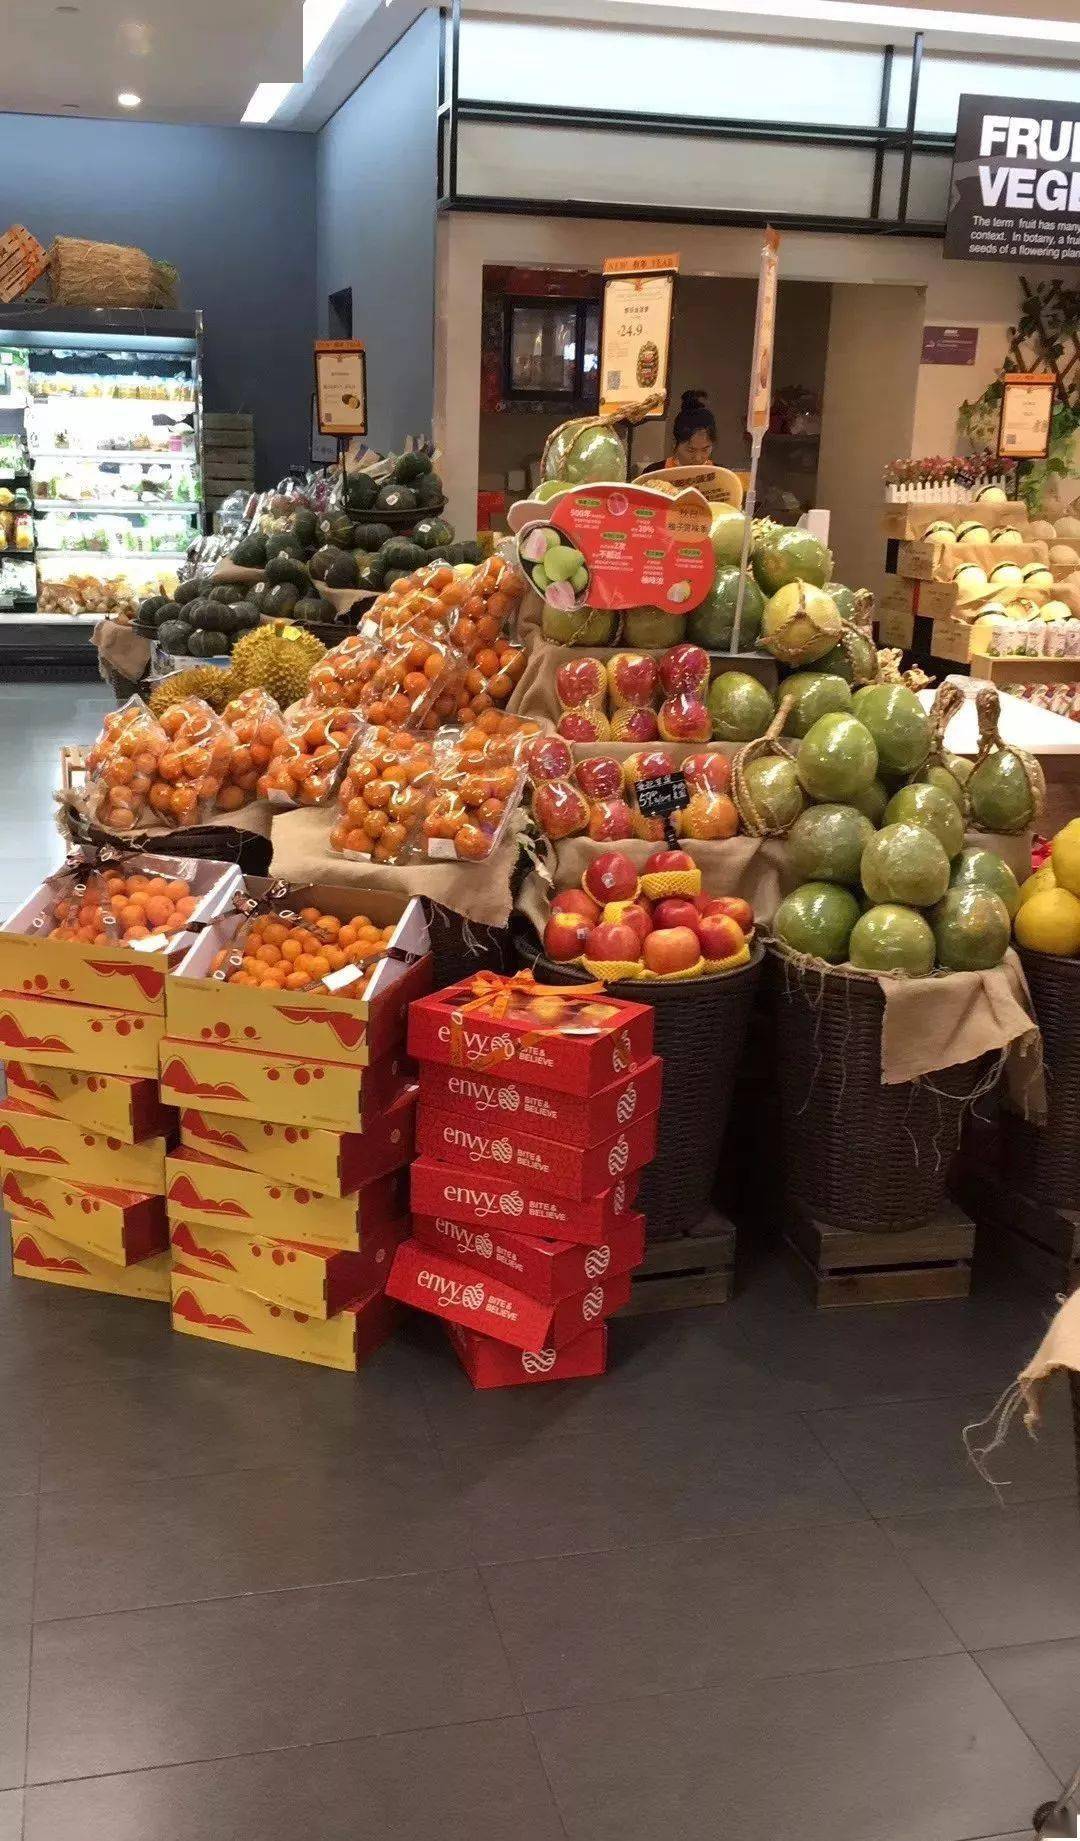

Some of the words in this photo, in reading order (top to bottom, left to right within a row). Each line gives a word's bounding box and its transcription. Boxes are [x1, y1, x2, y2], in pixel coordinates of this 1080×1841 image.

[973, 215, 991, 227] The
[992, 217, 1014, 228] term
[1019, 218, 1037, 229] fruit
[1038, 219, 1056, 231] has
[970, 231, 1007, 241] context.
[1012, 232, 1022, 242] In
[1023, 232, 1056, 248] botany,
[1058, 236, 1065, 245] a
[969, 244, 998, 254] seeds
[999, 244, 1009, 254] of
[1010, 247, 1017, 255] a
[1019, 245, 1060, 259] flowering
[438, 1026, 489, 1060] evy
[519, 1052, 554, 1068] BELIEVE
[448, 1077, 499, 1111] envy
[524, 1096, 542, 1106] BITE
[524, 1103, 558, 1119] BELIEVE
[443, 1127, 492, 1162] envy
[517, 1149, 535, 1159] BITE
[517, 1157, 550, 1173] BELIEVE
[443, 1185, 500, 1217] envy
[529, 1200, 549, 1211] BITE
[529, 1208, 566, 1221] BELIEVE
[435, 1217, 475, 1253] envy
[417, 1270, 464, 1307] envy
[488, 1295, 507, 1308] BITE
[485, 1303, 518, 1321] BELIEVE
